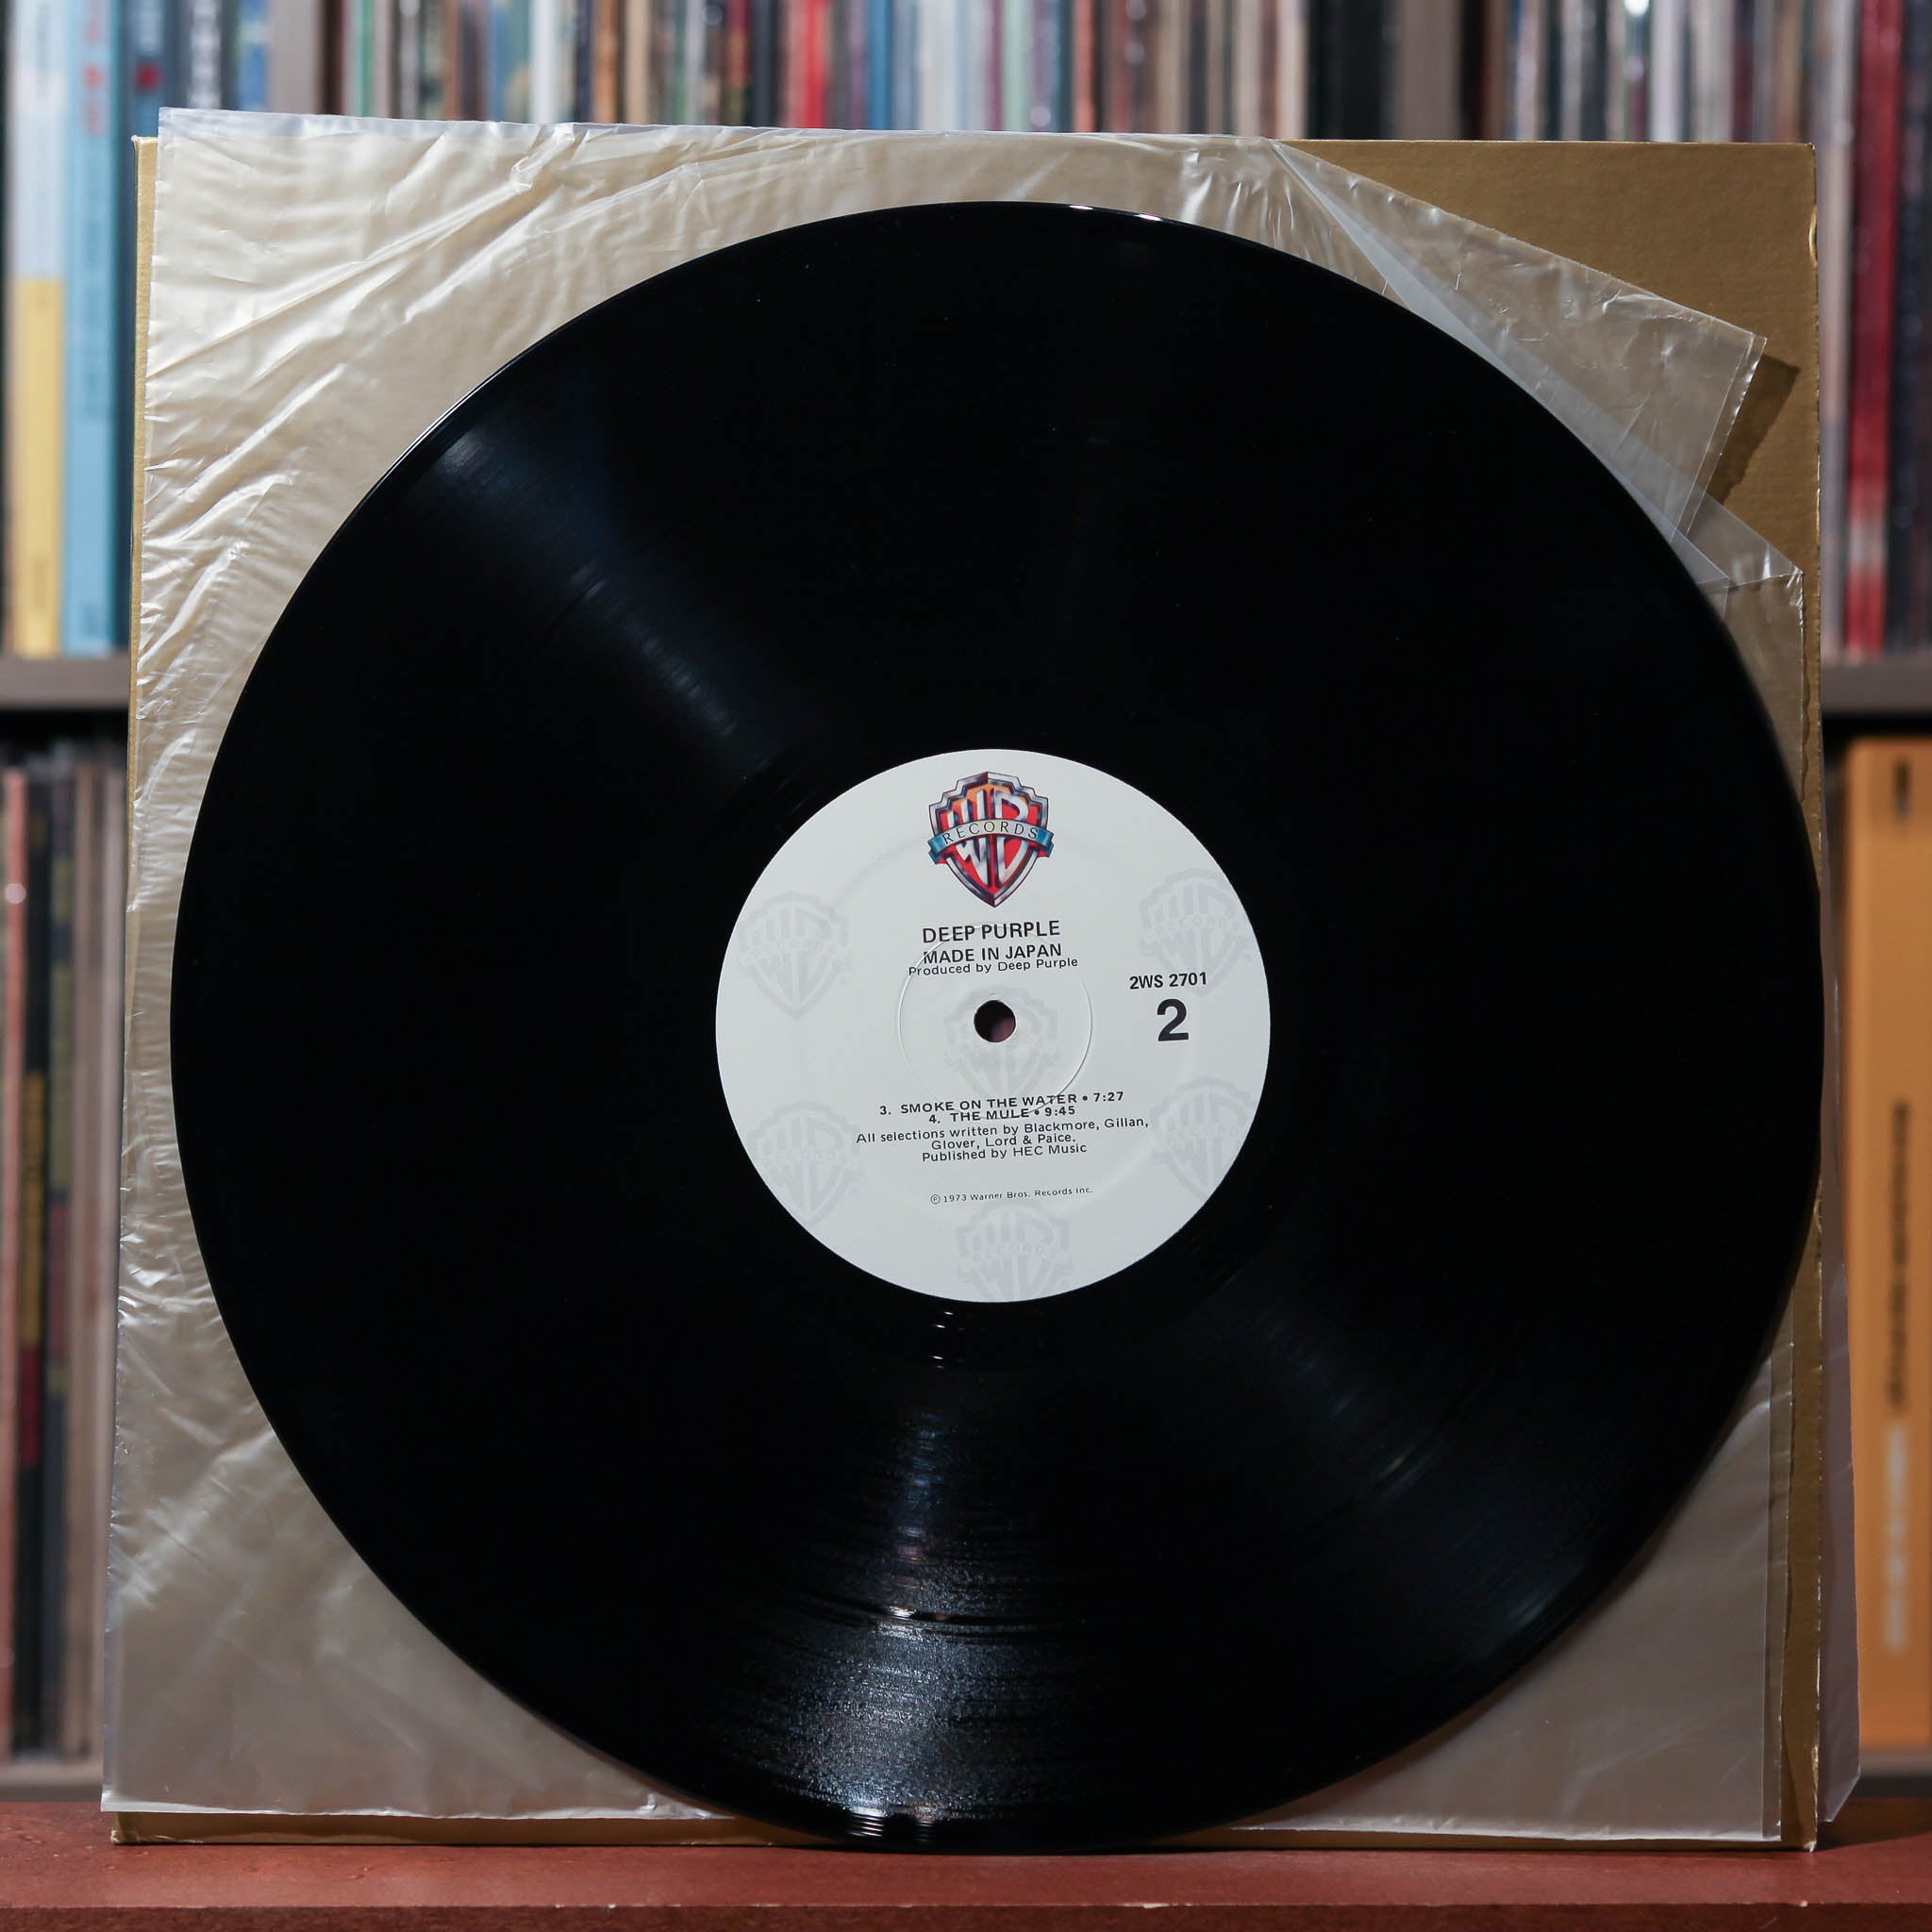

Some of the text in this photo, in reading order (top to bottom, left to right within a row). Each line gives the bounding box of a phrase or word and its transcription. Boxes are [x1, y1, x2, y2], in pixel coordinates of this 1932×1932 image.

[943, 821, 1039, 845] RECORDS
[923, 920, 1060, 944] DEEP PURPLE
[924, 943, 1061, 964] MADE IN JAPAN
[908, 958, 1078, 976] Produced by Deep Purple
[1129, 972, 1207, 990] 2WS 2701
[1157, 998, 1189, 1041] 2
[879, 1091, 1124, 1115] 3. SMOKE ON THE WATER 7:27
[928, 1106, 1075, 1124] 4. THE MULE 9:45
[857, 1118, 1149, 1143] All selections written by Blackmore, Gillan,
[931, 1134, 1076, 1150] Glover, Lord & Paice.
[922, 1143, 1088, 1162] Published by HEC Music
[943, 1193, 967, 1203] 1973
[970, 1192, 1004, 1201] Warner
[1007, 1191, 1031, 1199] Bros.
[1034, 1188, 1073, 1197] Records
[1075, 1186, 1094, 1194] Inc.
